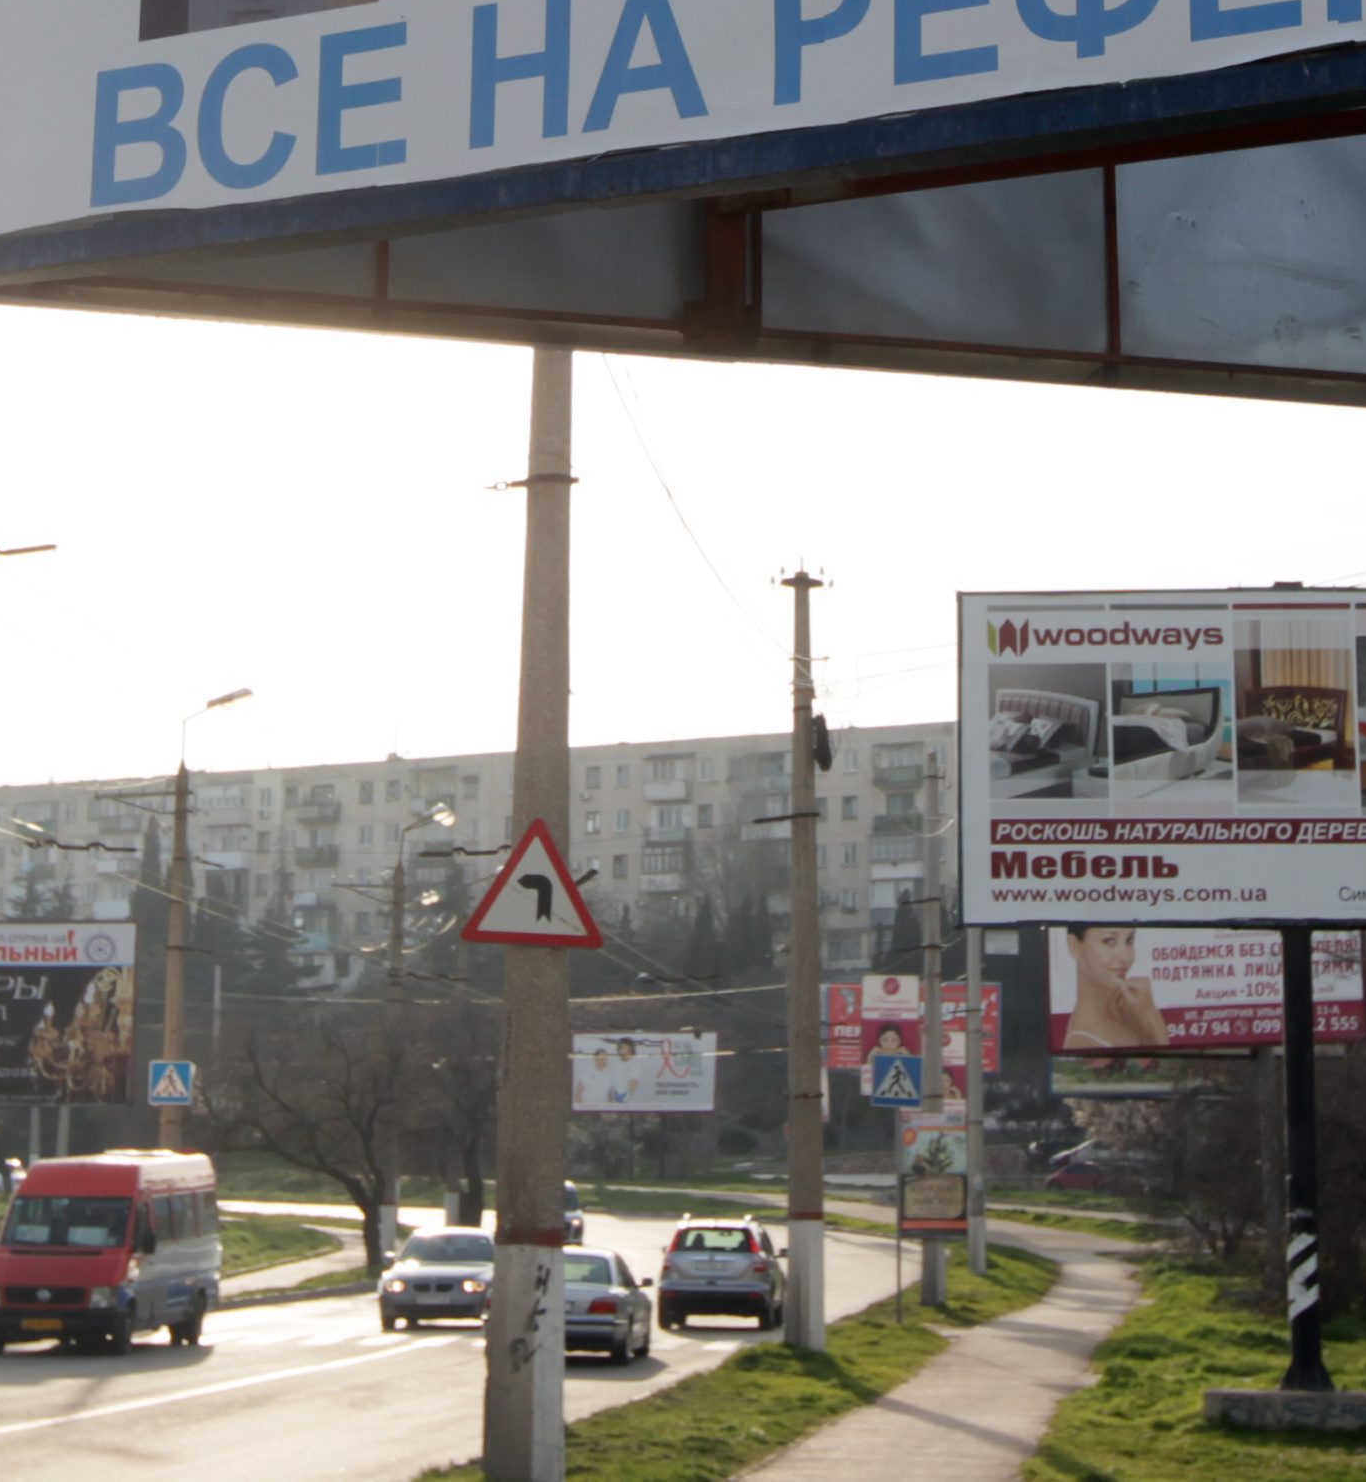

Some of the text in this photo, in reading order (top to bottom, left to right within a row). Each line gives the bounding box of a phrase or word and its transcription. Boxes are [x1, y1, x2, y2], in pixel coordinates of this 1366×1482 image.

[90, 20, 409, 209] ВСЕ
[1032, 621, 1224, 650] woodways
[995, 823, 1108, 841] РОСКОШЬ
[1114, 822, 1292, 841] НАТУРАЛЬНОГО
[990, 850, 1179, 879] Мебель
[991, 885, 1267, 906] www.woodways.com.ua
[1151, 943, 1234, 961] ОБОЙДЕМСЯ
[1239, 942, 1265, 958] БЕЗ
[1151, 965, 1235, 982] ПОДТЯЖКА
